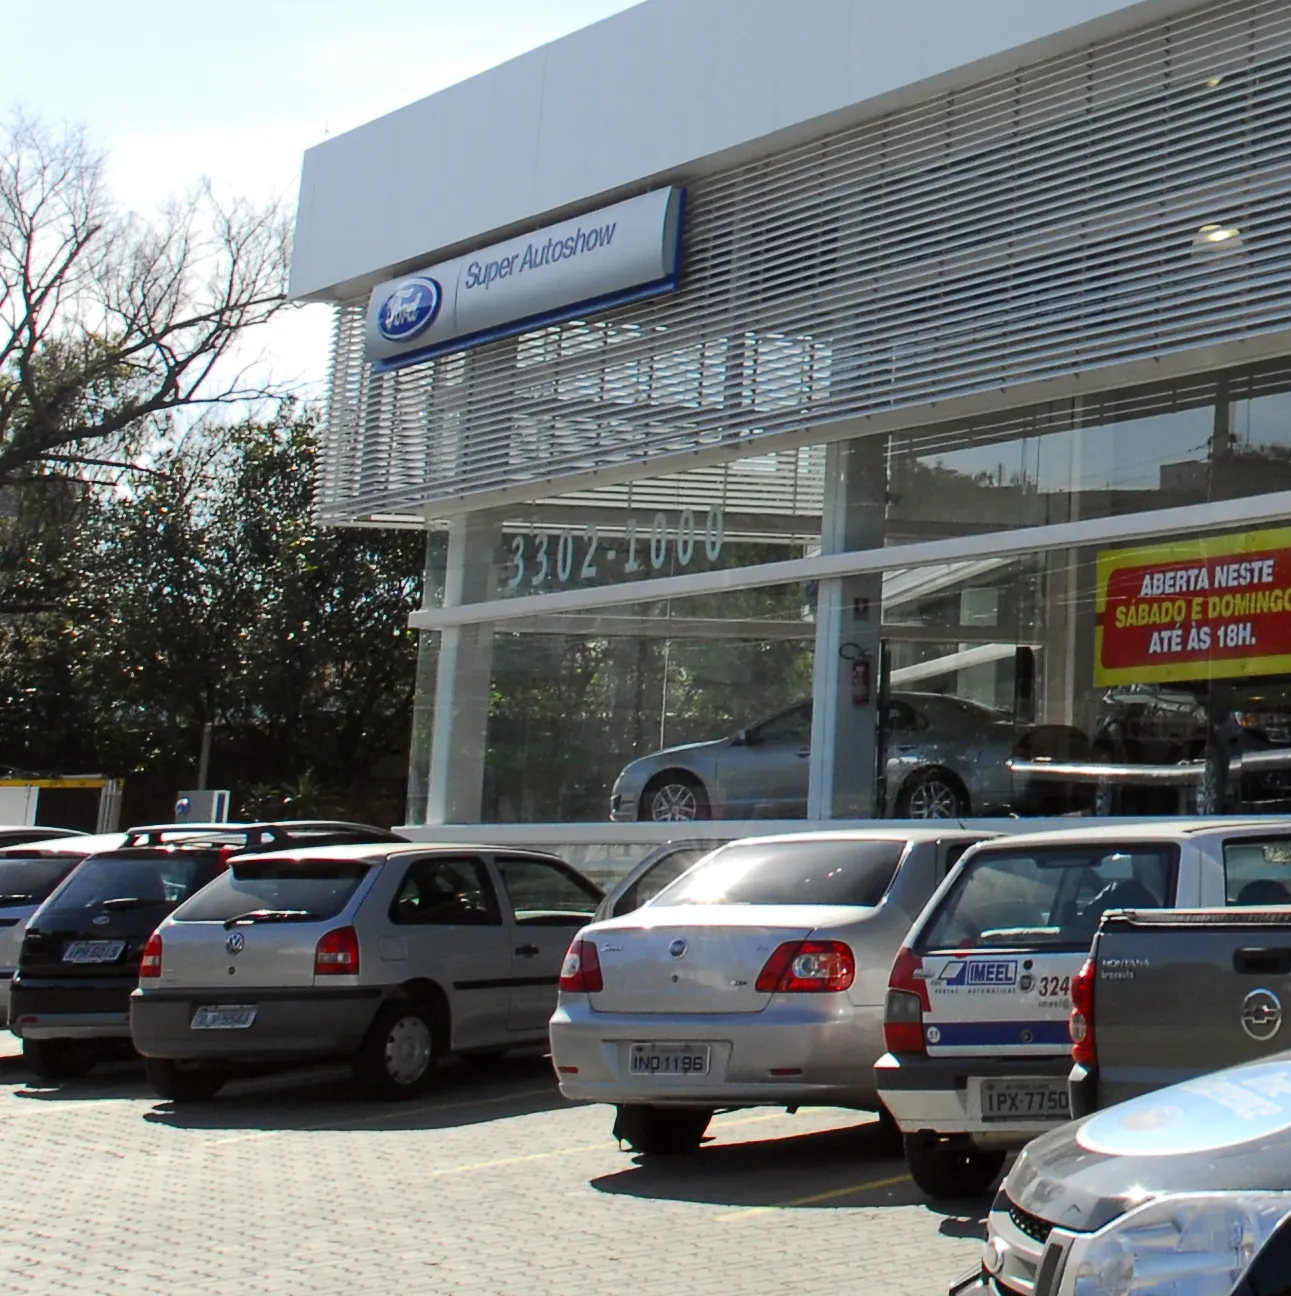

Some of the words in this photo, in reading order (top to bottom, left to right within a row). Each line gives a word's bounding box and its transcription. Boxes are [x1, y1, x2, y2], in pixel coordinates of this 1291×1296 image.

[465, 254, 518, 290] Super
[519, 222, 617, 272] Autoshow
[385, 288, 423, 328] Ford
[508, 505, 725, 588] 3302-1000
[1140, 568, 1209, 596] ABERTA
[1214, 559, 1275, 588] NESTE
[1116, 597, 1186, 628] SÁBADO
[1191, 597, 1203, 618] E
[1149, 623, 1182, 654] ATÉ
[1187, 622, 1212, 650] ÀS
[1217, 622, 1256, 647] 18H.
[970, 963, 1014, 983] IMEEL
